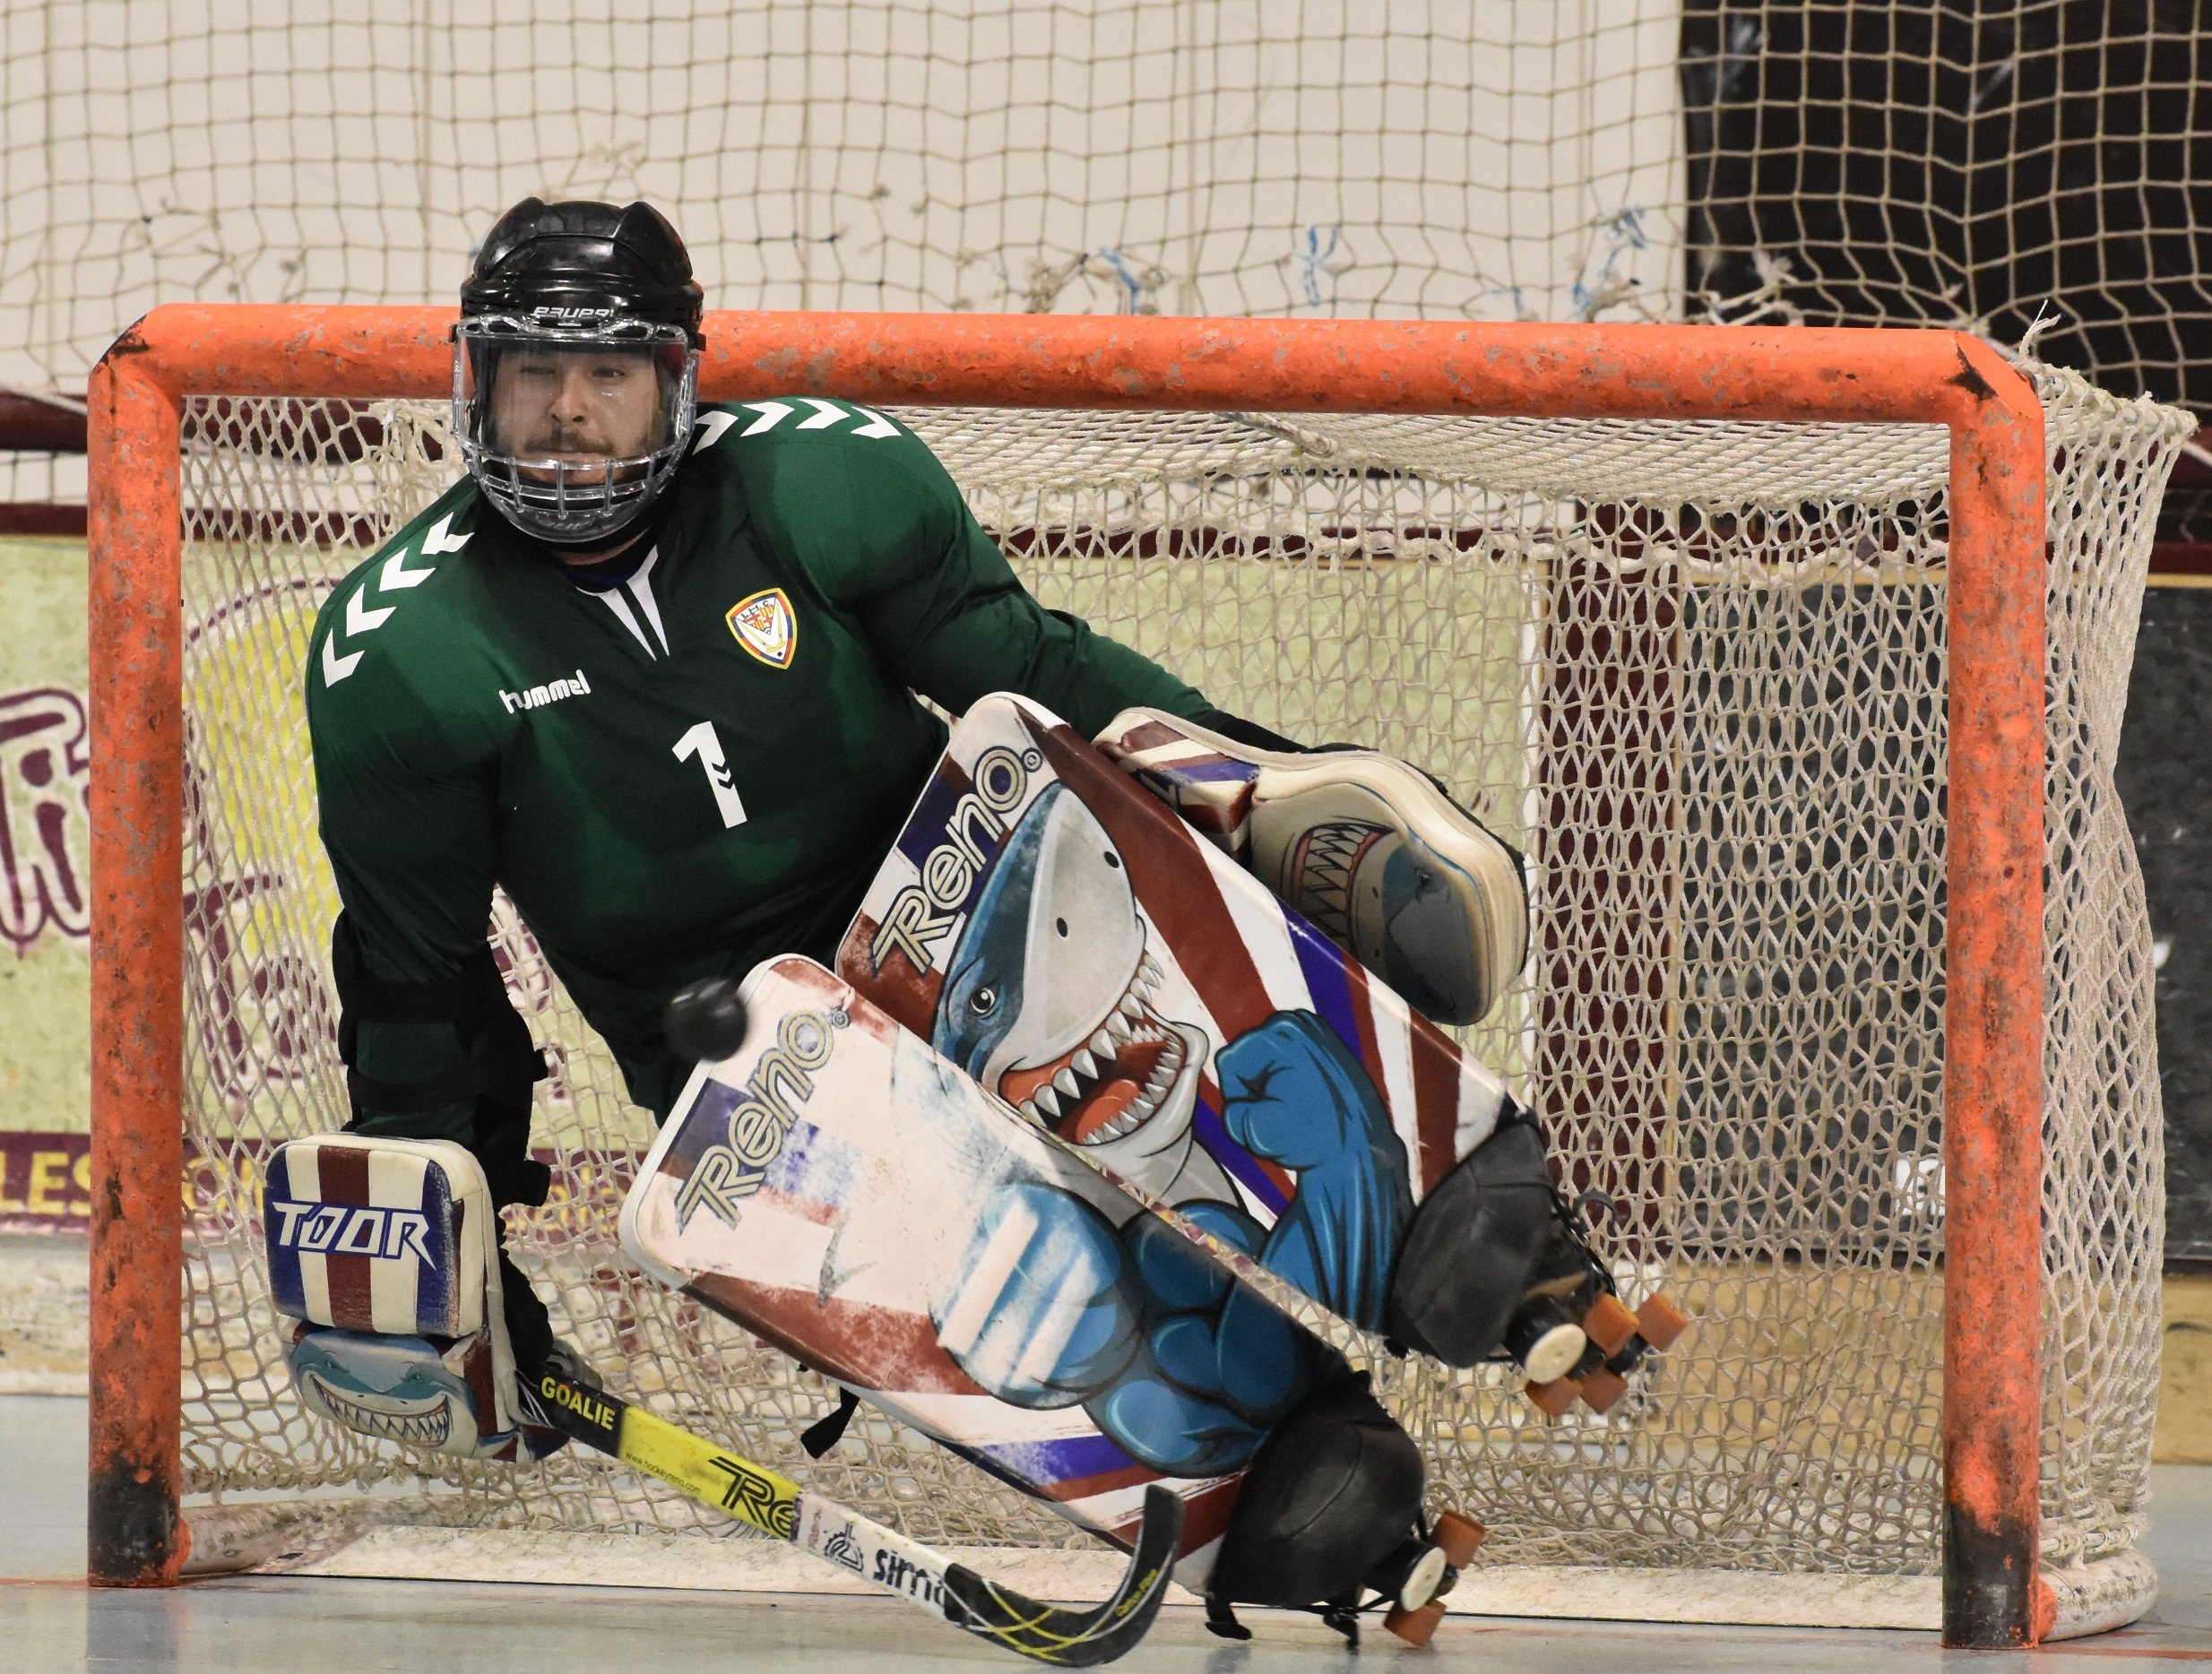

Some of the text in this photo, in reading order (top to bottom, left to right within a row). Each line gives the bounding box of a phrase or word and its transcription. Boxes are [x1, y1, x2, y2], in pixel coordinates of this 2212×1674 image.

[499, 669, 592, 714] hummel
[671, 721, 747, 829] 1
[871, 745, 1029, 975] Reno
[674, 1009, 835, 1236] Reno
[272, 1201, 436, 1270] TOOR
[540, 1375, 617, 1431] GOALIE
